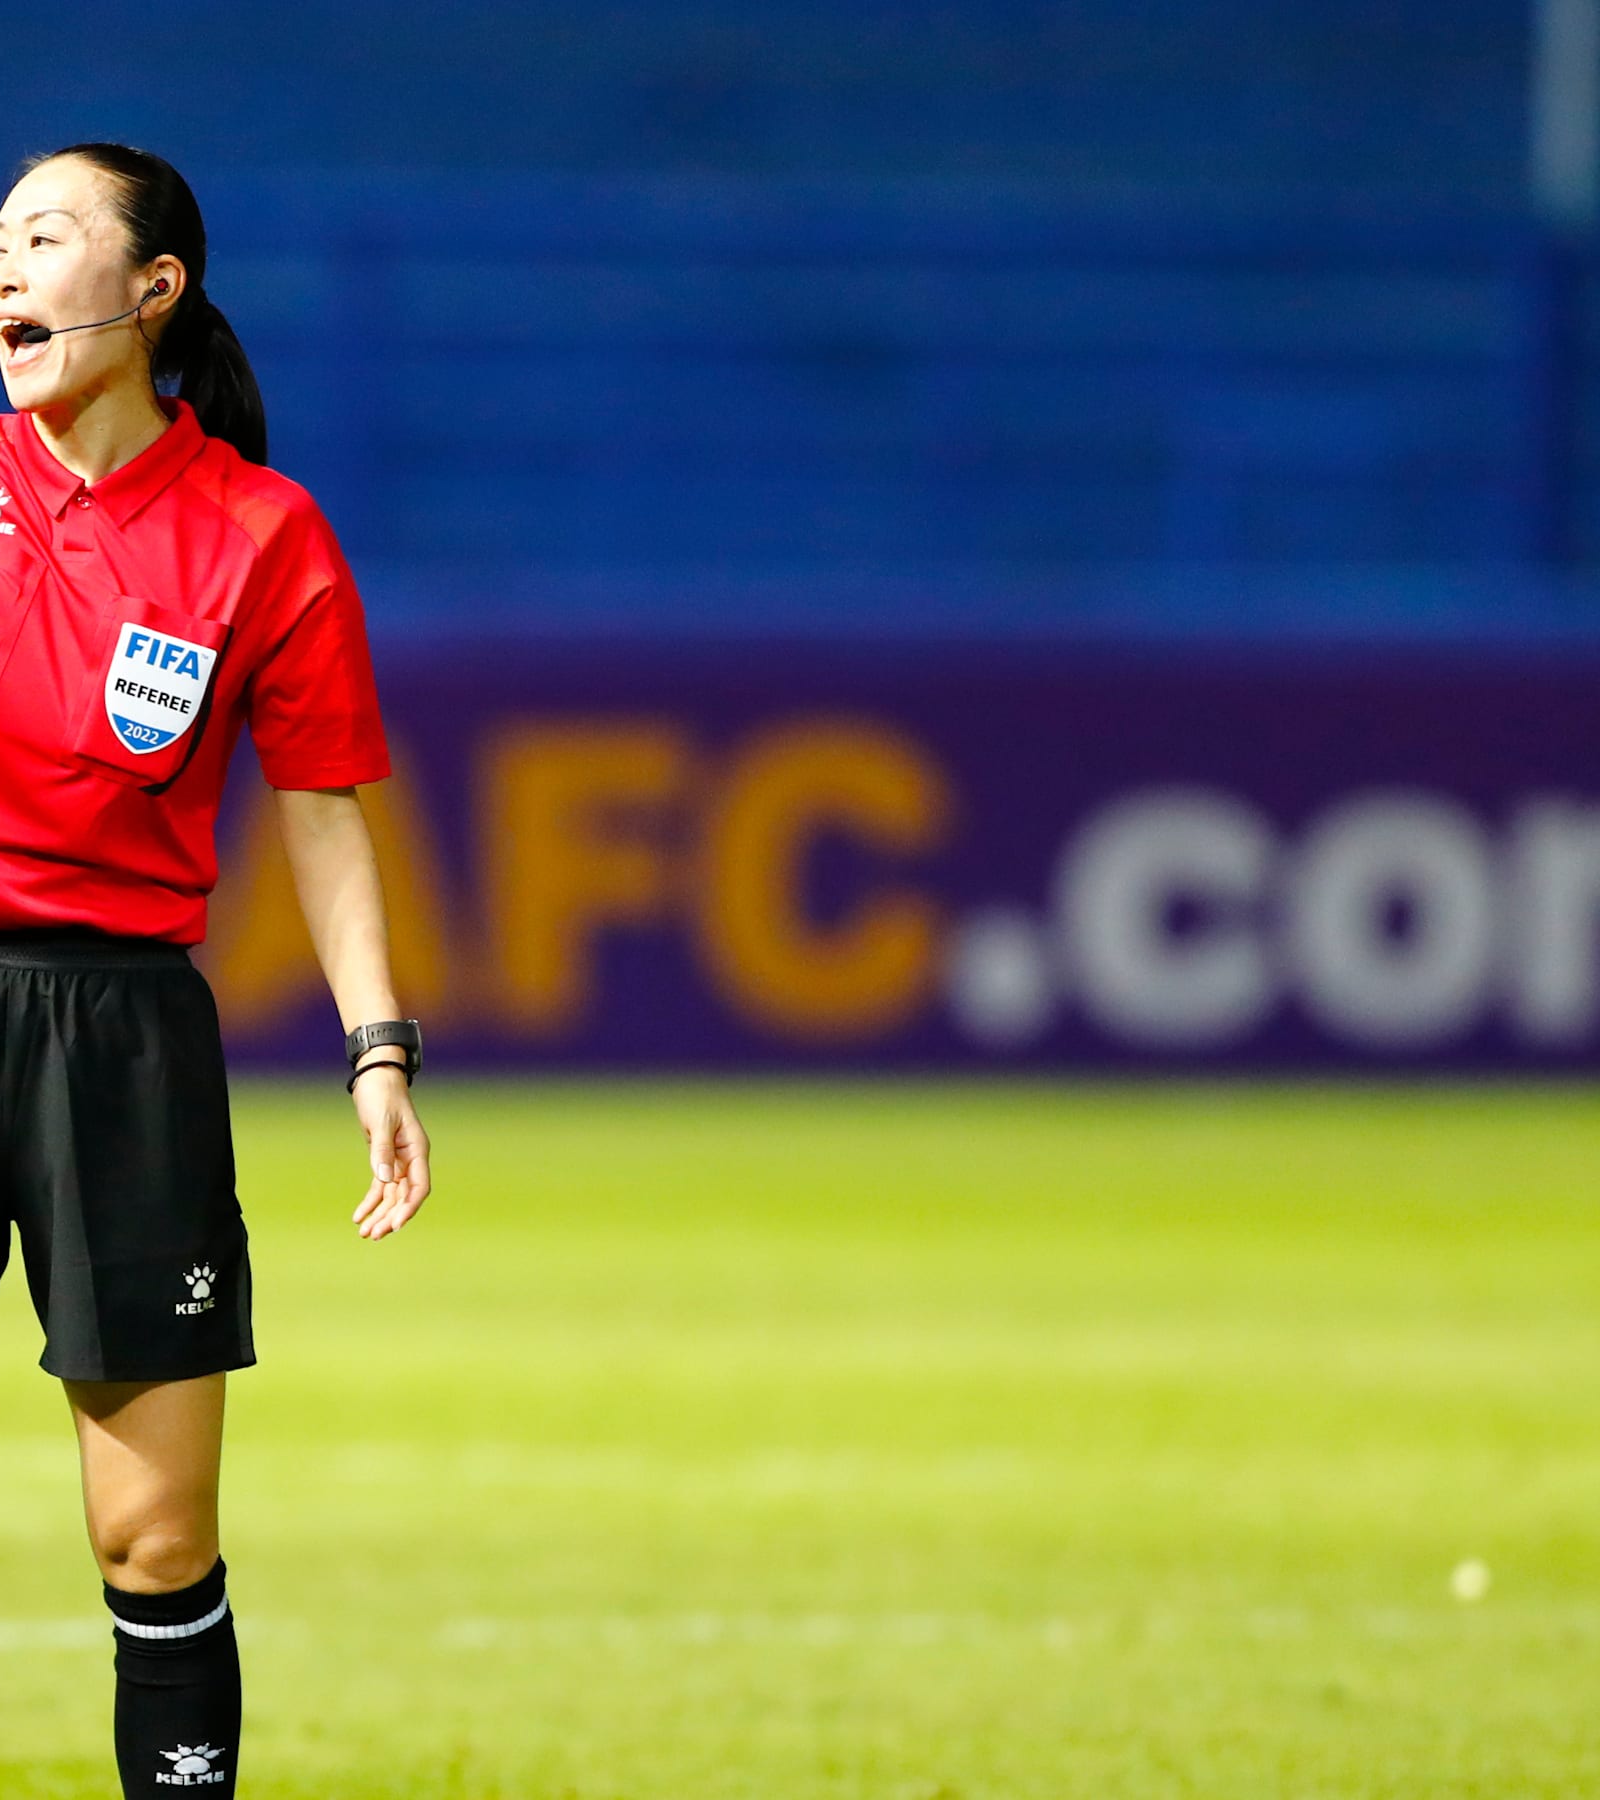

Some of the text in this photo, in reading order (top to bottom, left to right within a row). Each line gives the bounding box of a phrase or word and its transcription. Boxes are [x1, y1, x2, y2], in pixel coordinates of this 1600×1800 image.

[125, 631, 199, 680] FIFA
[114, 677, 192, 714] REFEREE
[123, 722, 160, 745] 2022
[155, 1770, 225, 1786] KELME
